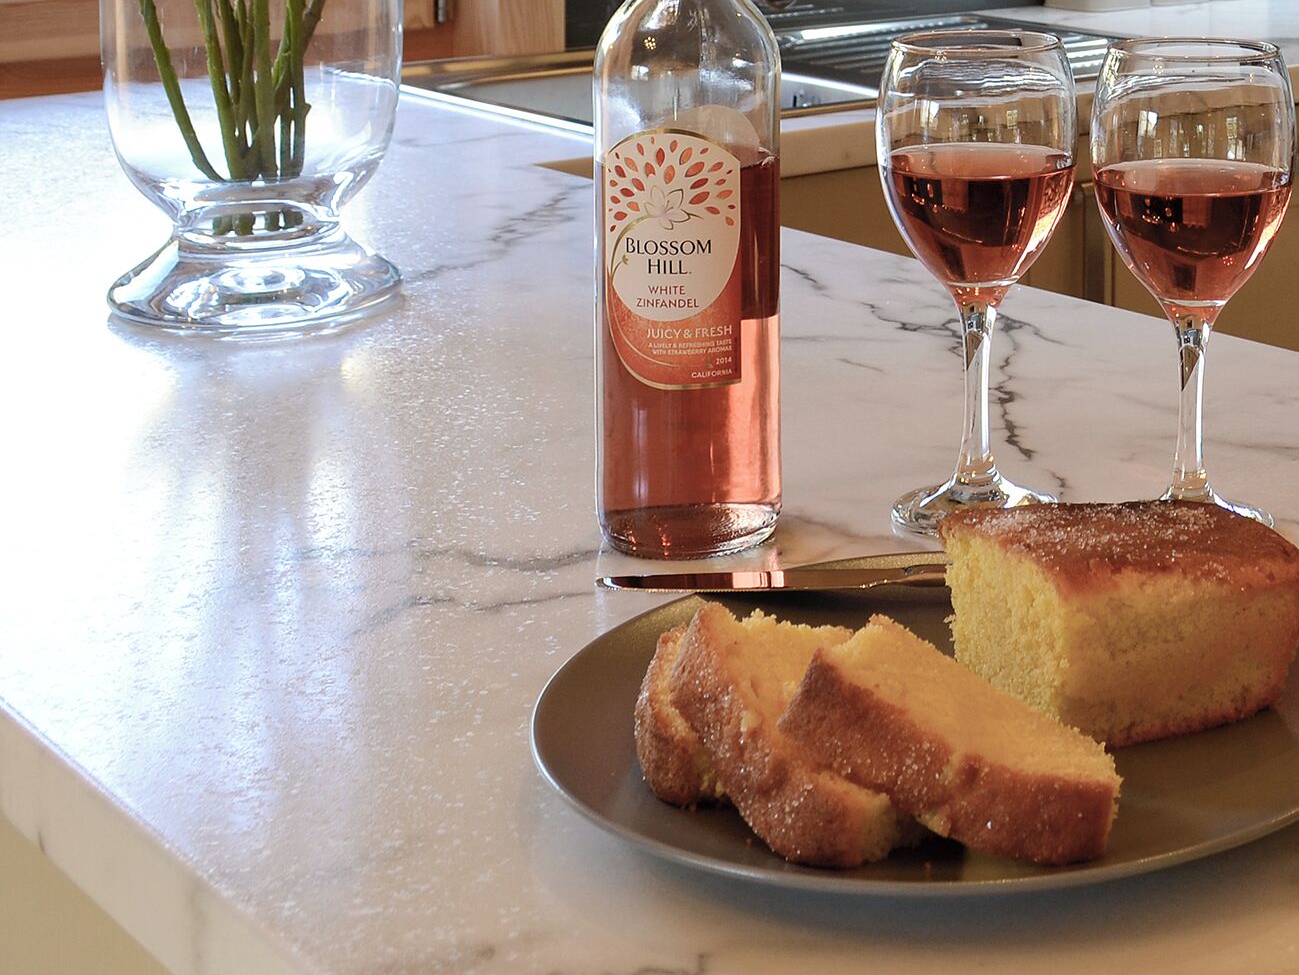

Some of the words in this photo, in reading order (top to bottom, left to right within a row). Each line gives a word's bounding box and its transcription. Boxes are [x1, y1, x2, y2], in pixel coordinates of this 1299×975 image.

[626, 237, 712, 256] BLOSSOM
[647, 285, 686, 296] WHITE
[636, 297, 700, 309] ZINFANDEL
[646, 328, 682, 339] JUICY
[683, 329, 693, 339] &
[695, 325, 732, 338] FRESH
[715, 356, 732, 366] 2014
[691, 368, 732, 379] CALIFORNIA
